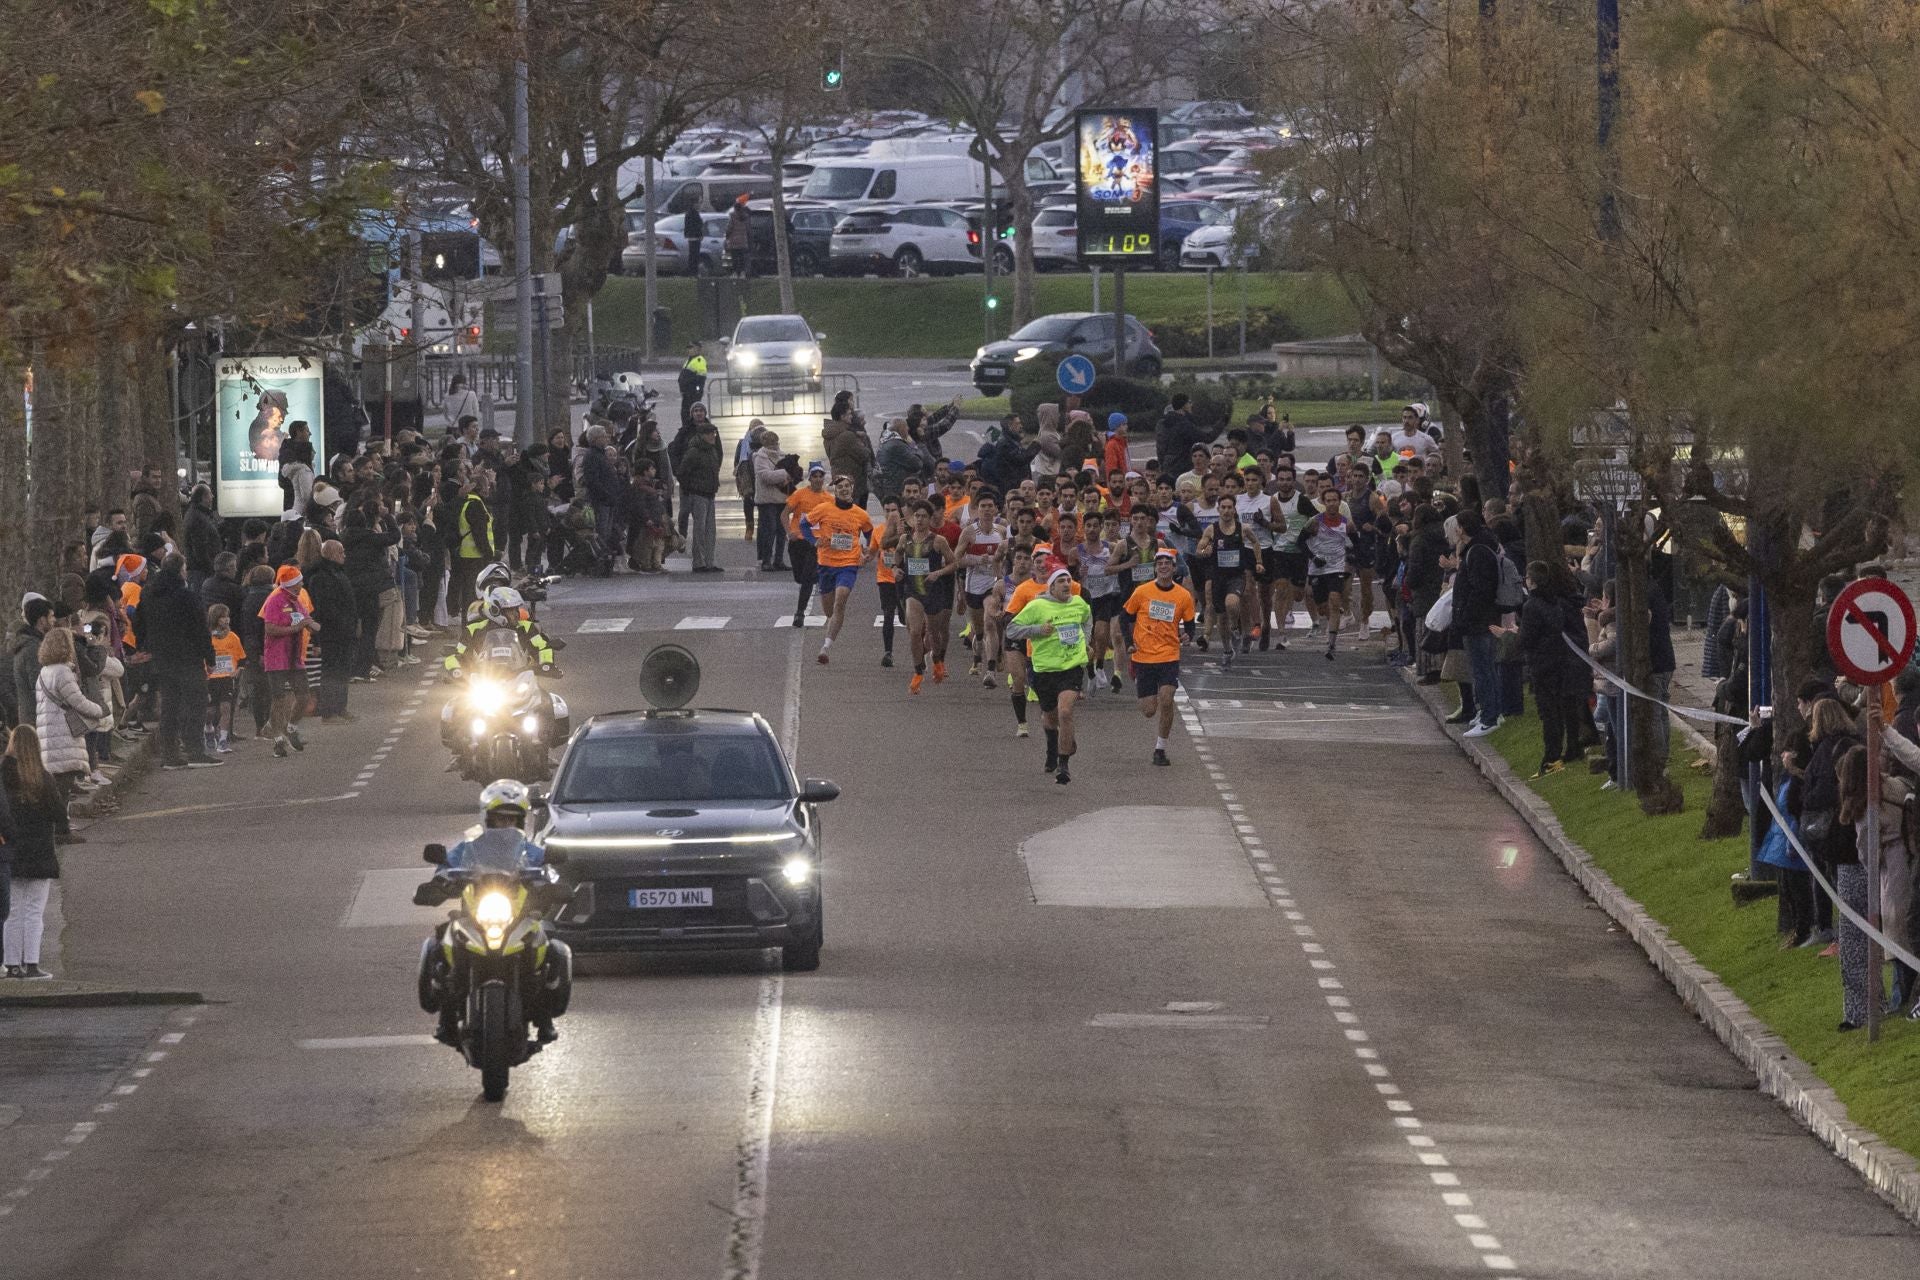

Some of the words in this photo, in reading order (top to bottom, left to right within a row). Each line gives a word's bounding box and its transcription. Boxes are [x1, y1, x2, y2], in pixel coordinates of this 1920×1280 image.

[260, 364, 303, 374] Movistar
[1151, 606, 1170, 616] 4890
[640, 892, 676, 905] 6570
[681, 891, 708, 904] MNL
